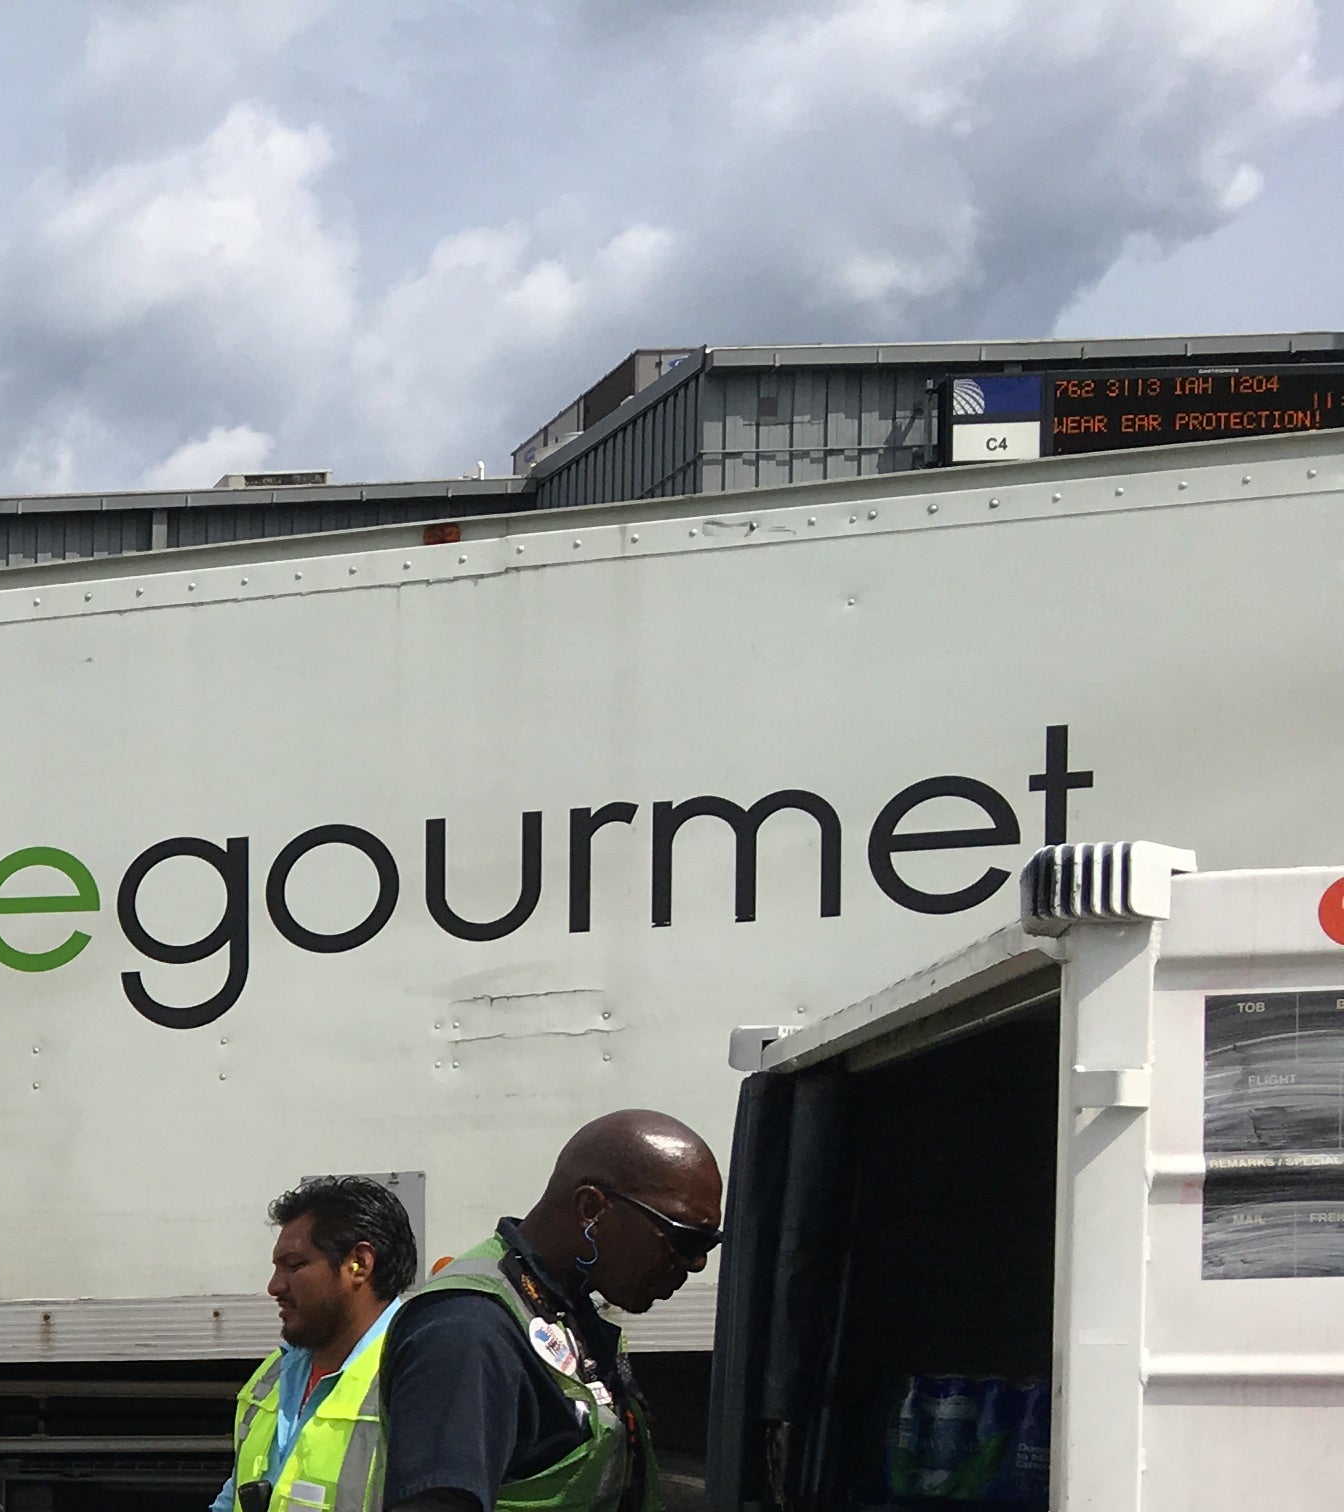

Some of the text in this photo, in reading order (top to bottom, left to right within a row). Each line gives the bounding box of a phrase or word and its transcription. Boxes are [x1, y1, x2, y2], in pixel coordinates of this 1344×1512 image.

[1056, 375, 1280, 398] 762 3113 IAH 1204
[1053, 410, 1321, 434] WEAR EAR PROTECTION!
[986, 437, 1008, 451] C4
[1236, 1002, 1266, 1013] TOB
[1248, 1074, 1297, 1086] FLIGHT
[1209, 1158, 1274, 1168] REMARKS
